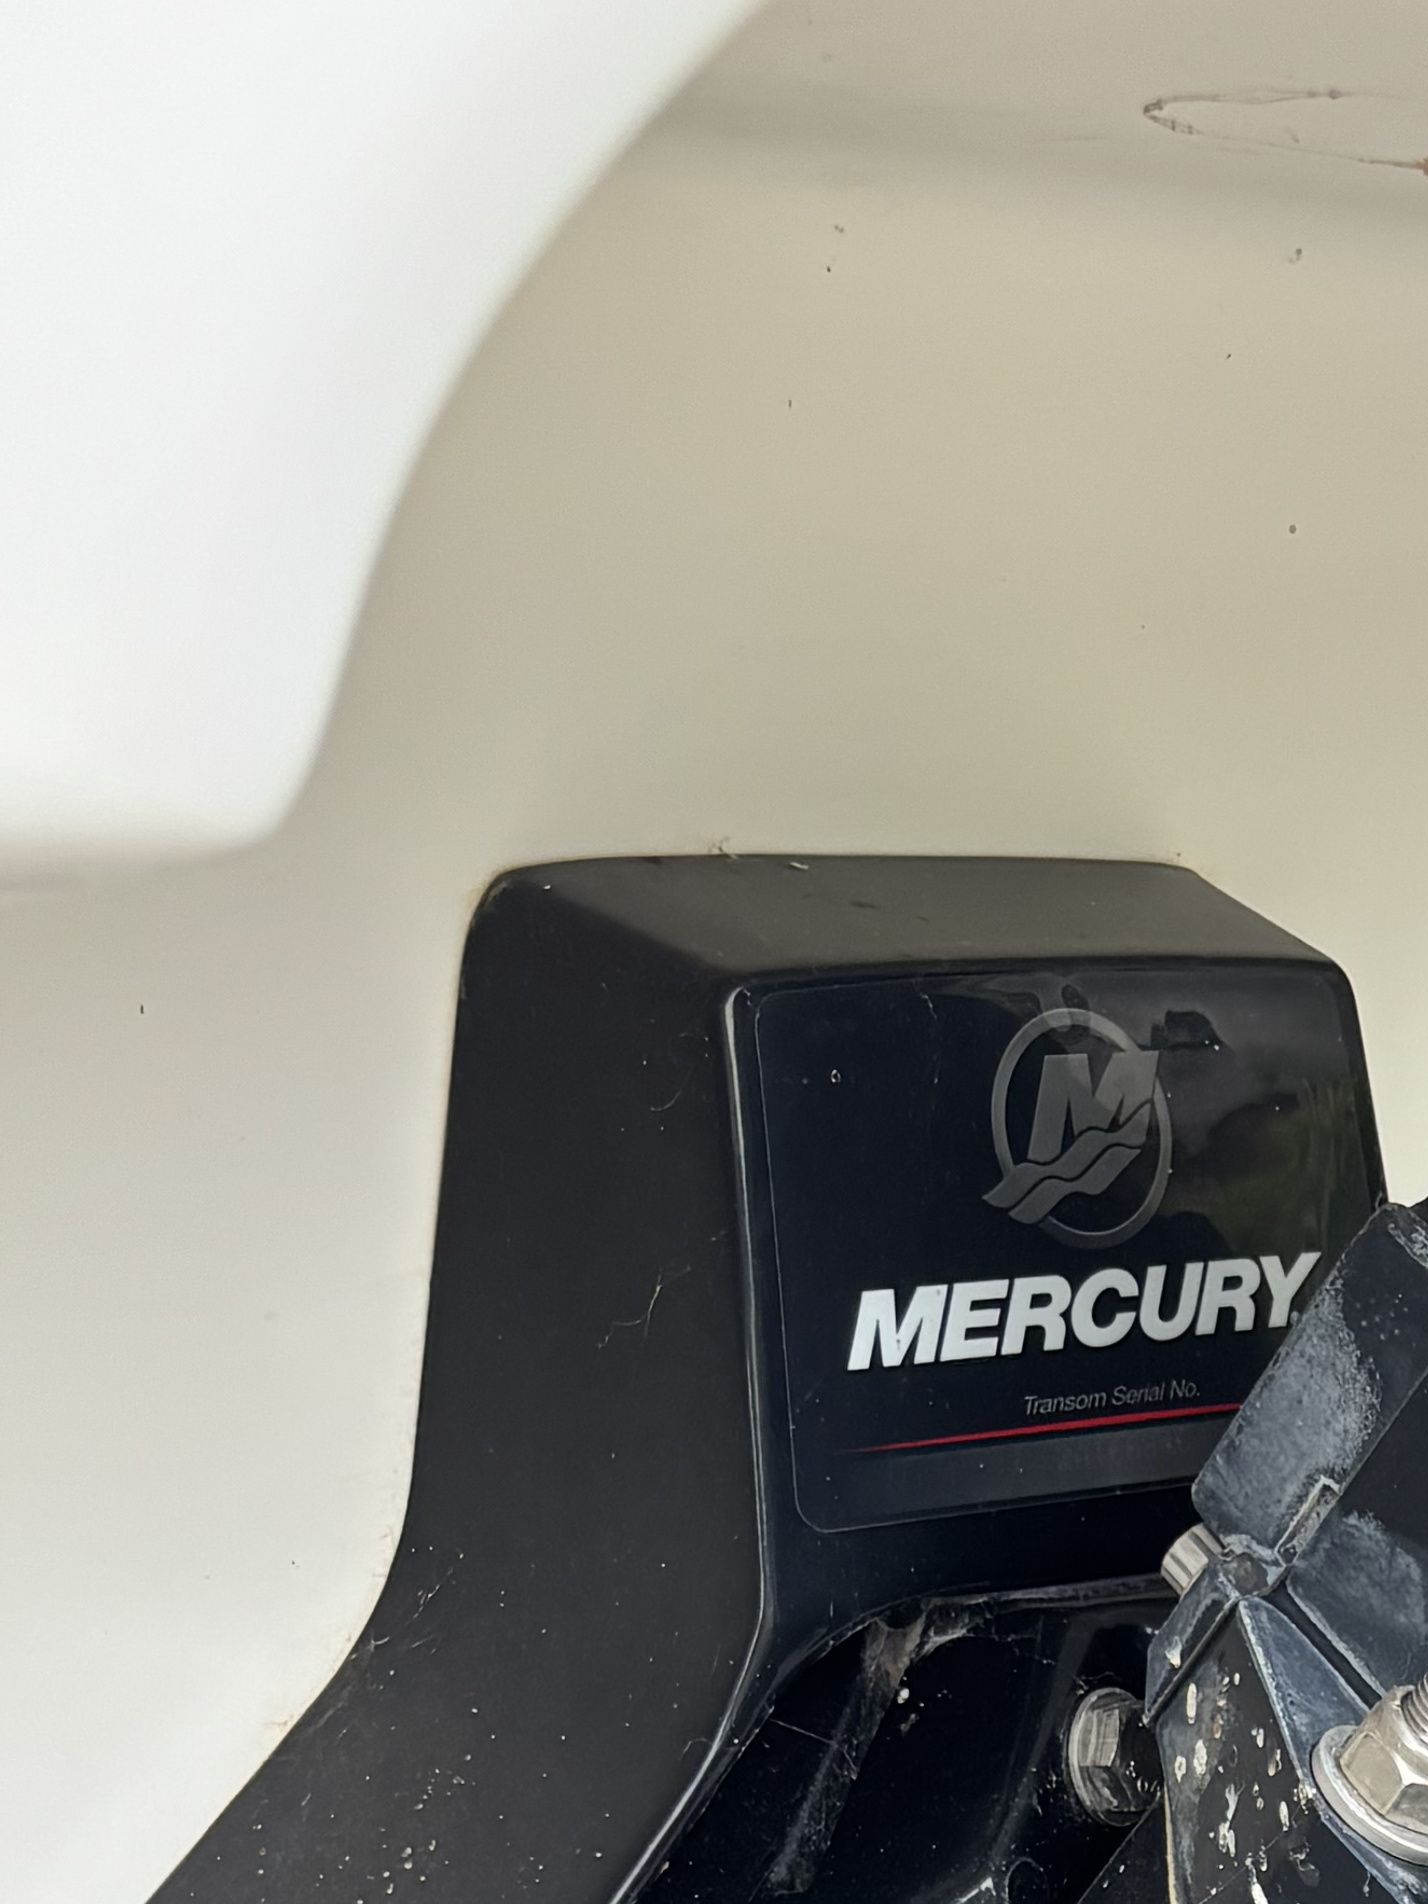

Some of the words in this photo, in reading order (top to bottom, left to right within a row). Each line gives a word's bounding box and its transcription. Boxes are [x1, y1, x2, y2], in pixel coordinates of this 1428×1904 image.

[846, 1251, 1322, 1372] MERCURY
[1024, 1394, 1107, 1416] Transom
[1112, 1383, 1166, 1406] Serial
[1169, 1378, 1201, 1400] No.
